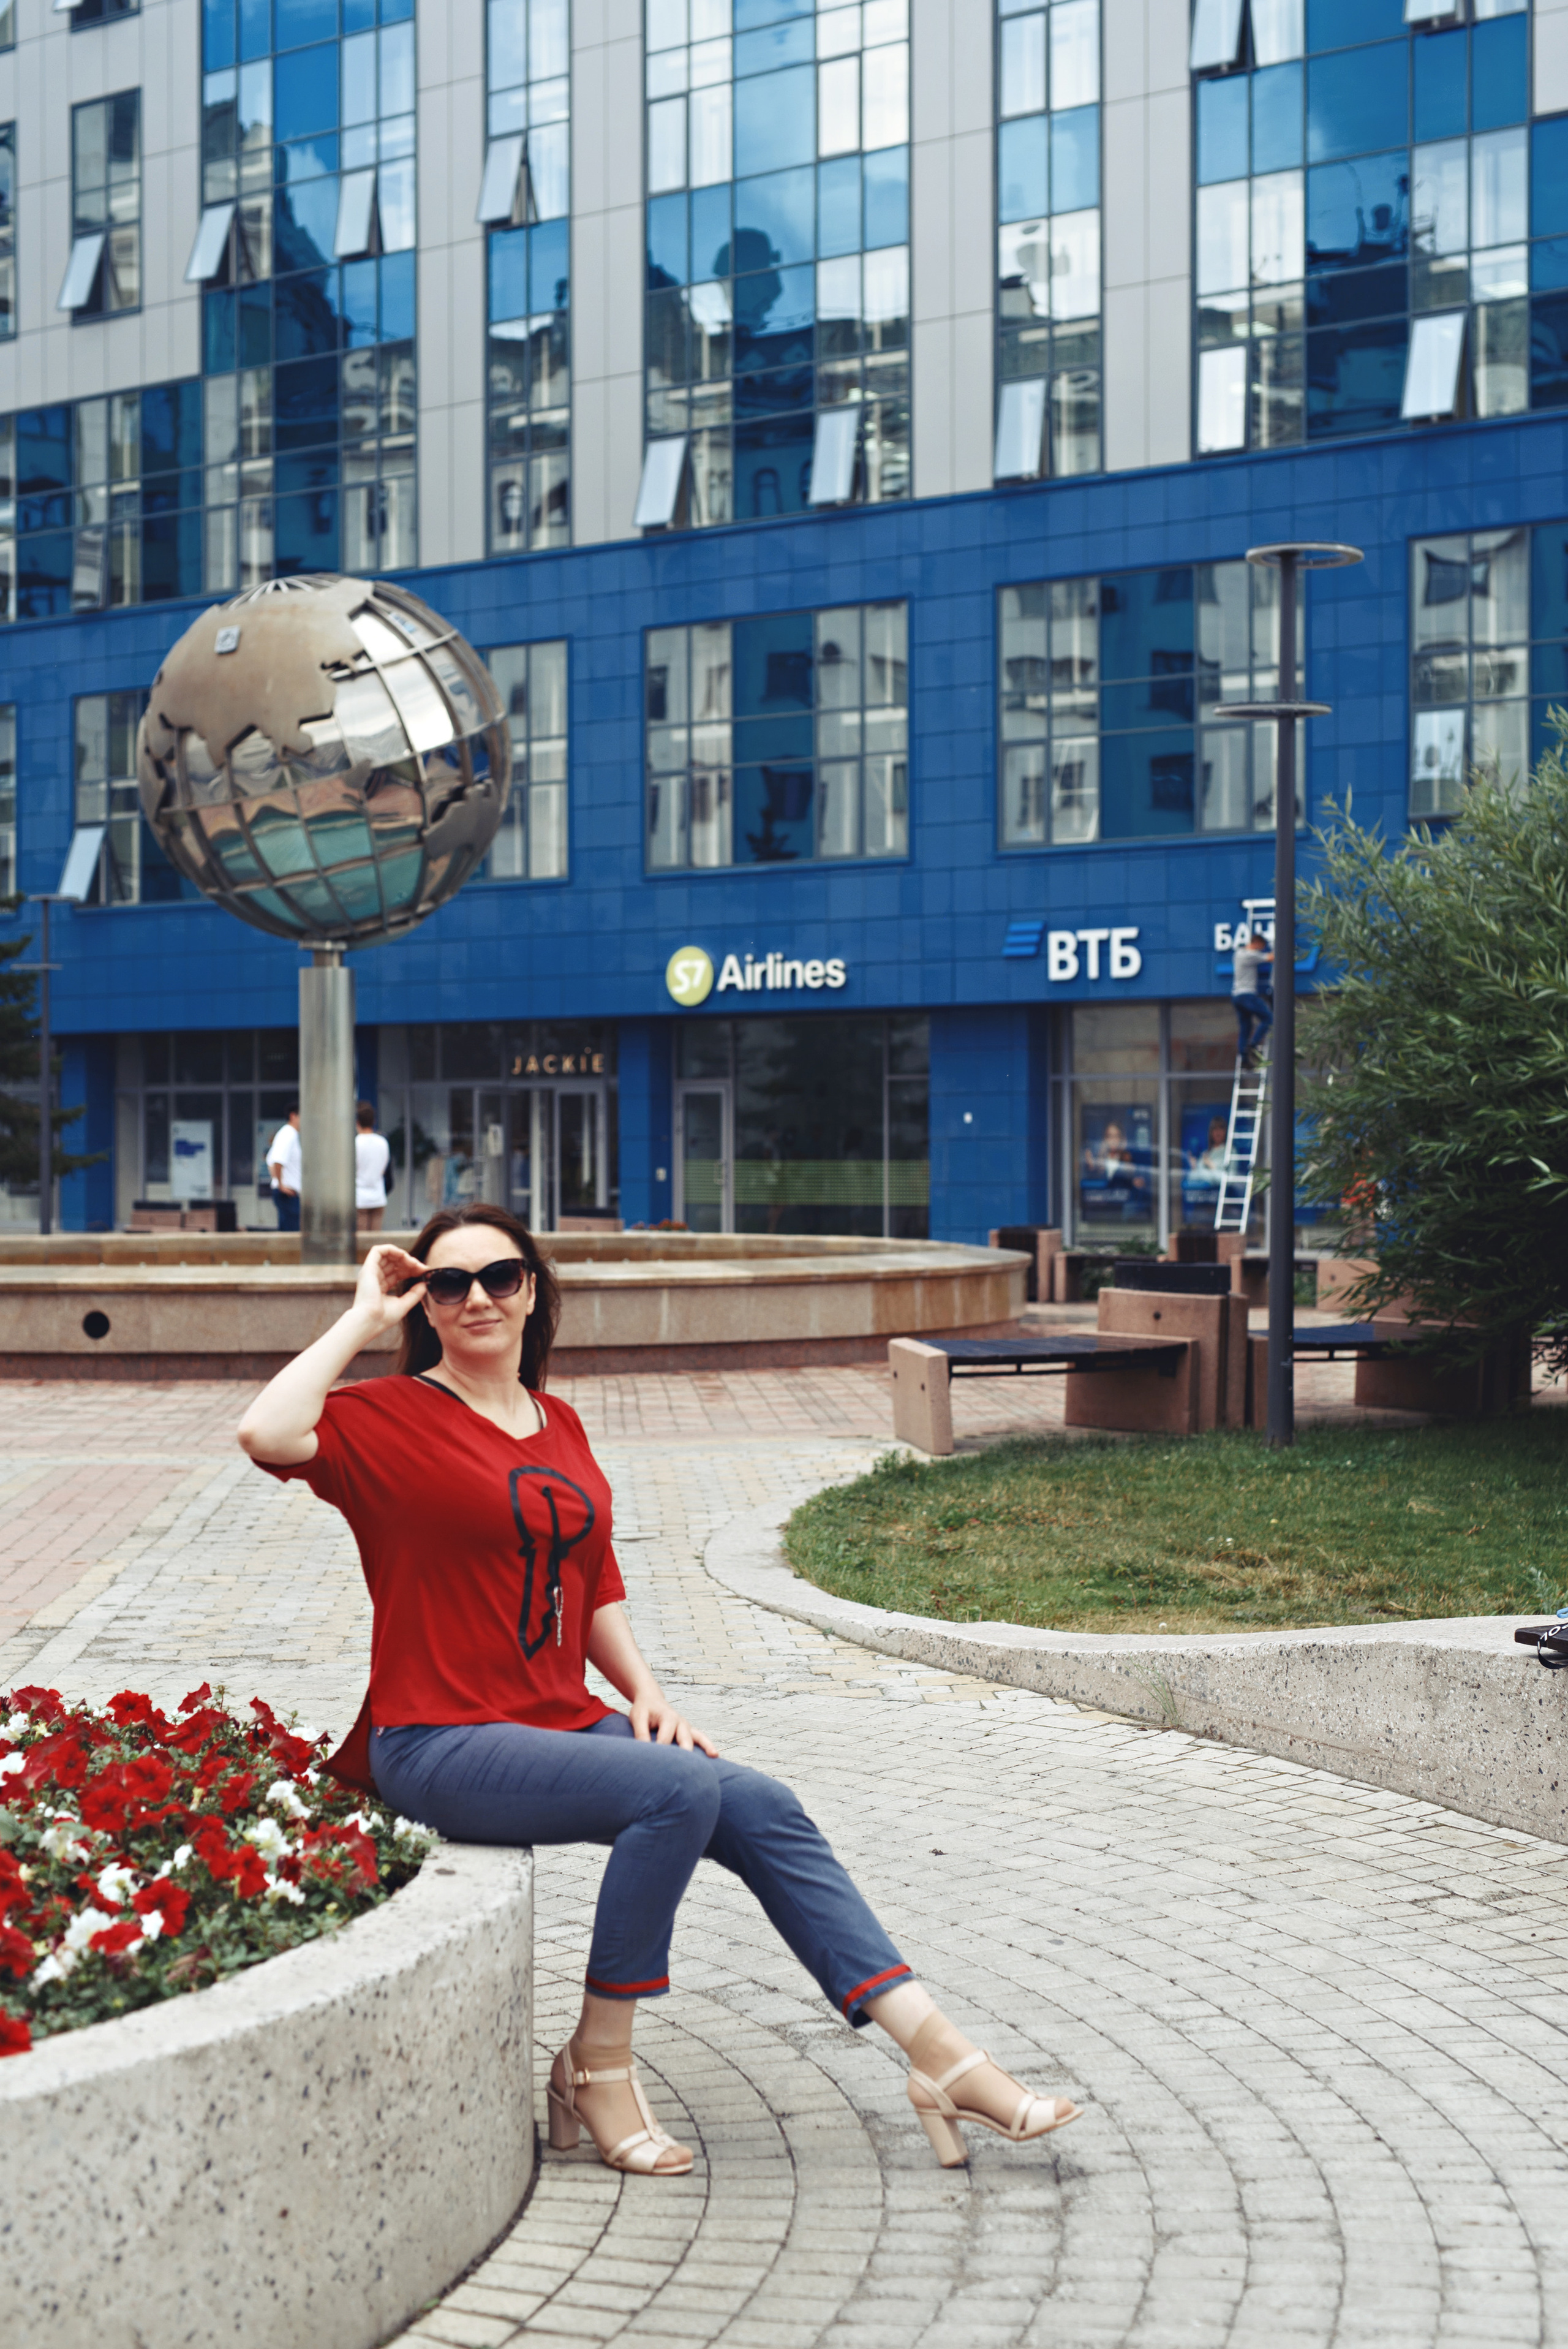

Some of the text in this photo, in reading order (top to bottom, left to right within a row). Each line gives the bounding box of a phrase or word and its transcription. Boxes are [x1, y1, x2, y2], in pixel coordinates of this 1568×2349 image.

[1047, 926, 1142, 981] ВТБ
[1215, 921, 1276, 951] БАН
[672, 952, 846, 994] S7 Airlines
[512, 1053, 605, 1075] JACKIE
